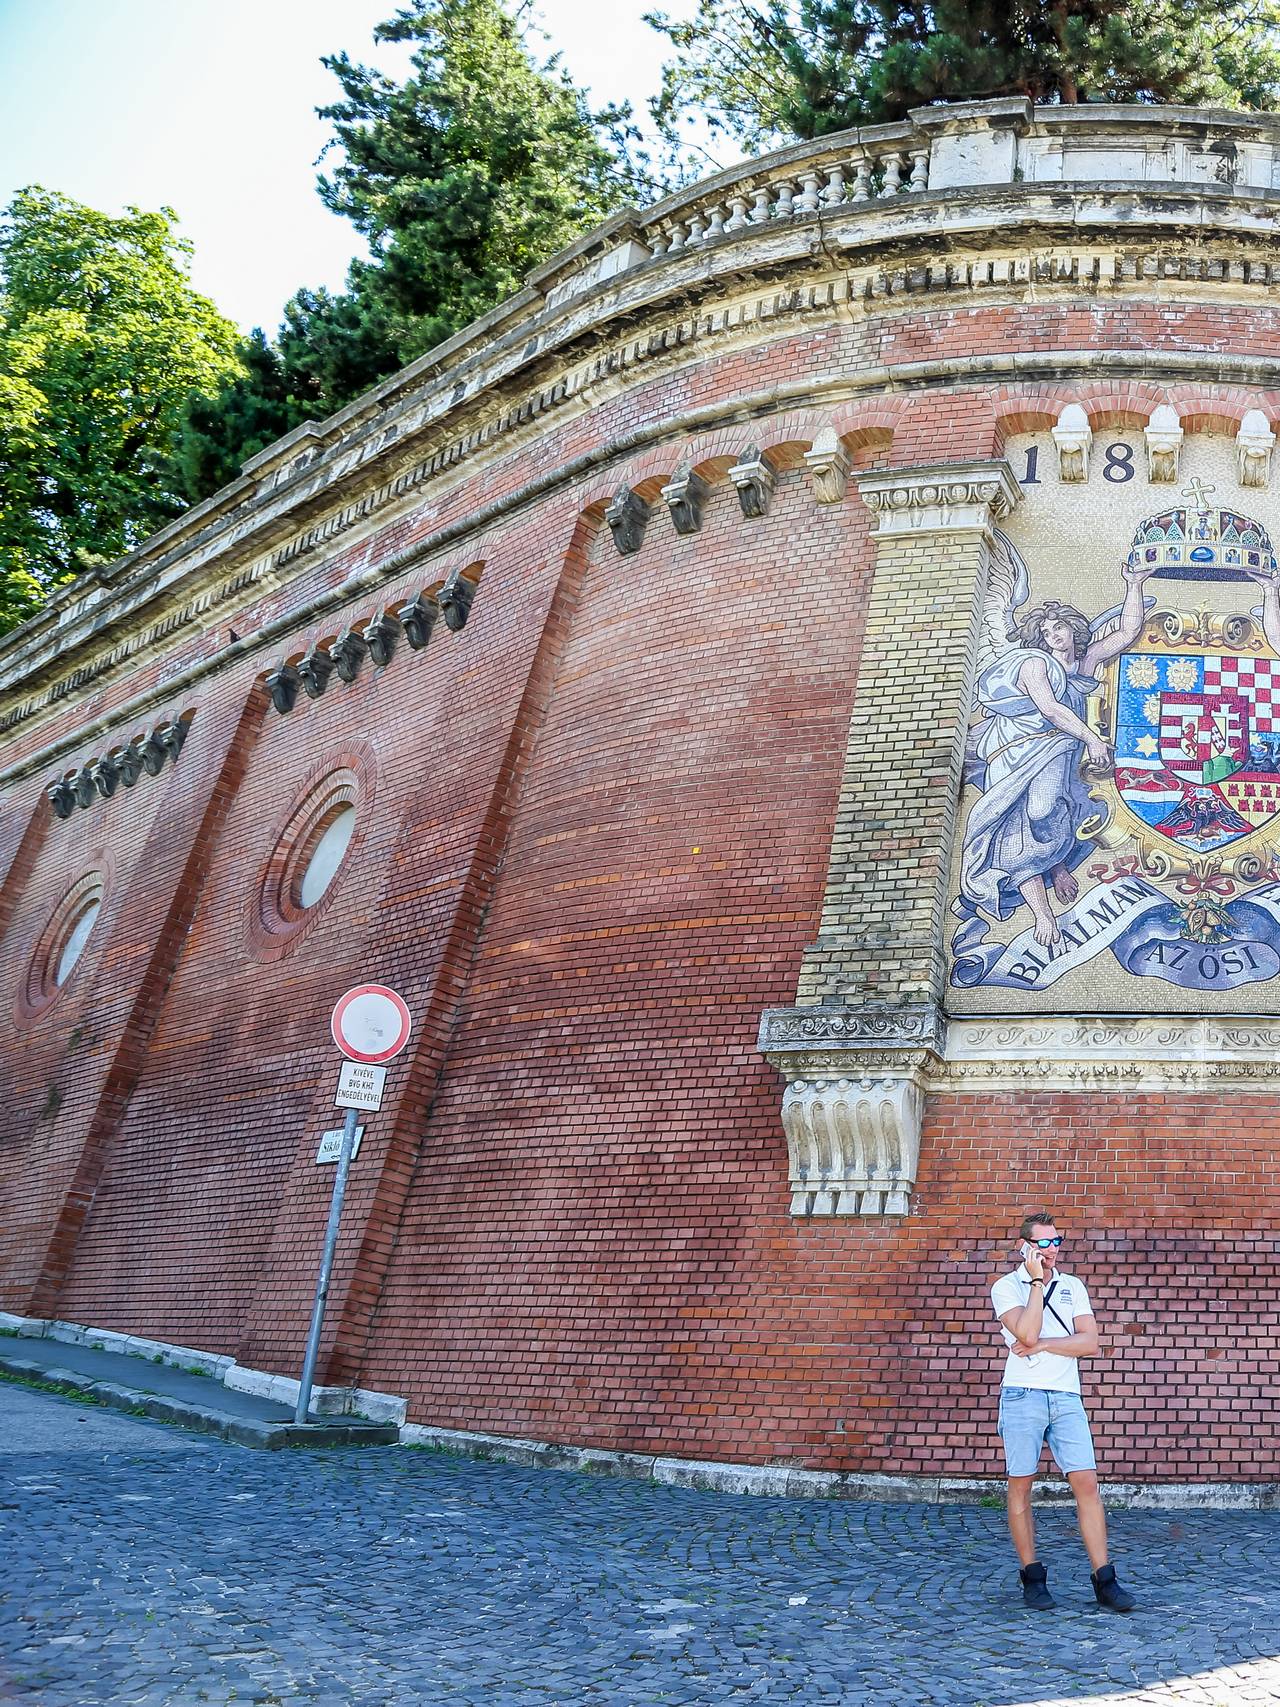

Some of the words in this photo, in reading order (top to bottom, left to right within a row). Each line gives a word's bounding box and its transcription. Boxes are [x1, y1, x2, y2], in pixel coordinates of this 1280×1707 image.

[1144, 941, 1190, 972] AZ
[1198, 946, 1260, 980] ŐSI
[352, 1067, 375, 1079] KIVÉVE
[361, 1080, 375, 1090] KHT
[337, 1089, 380, 1103] ENGEDÉLYÉVEL
